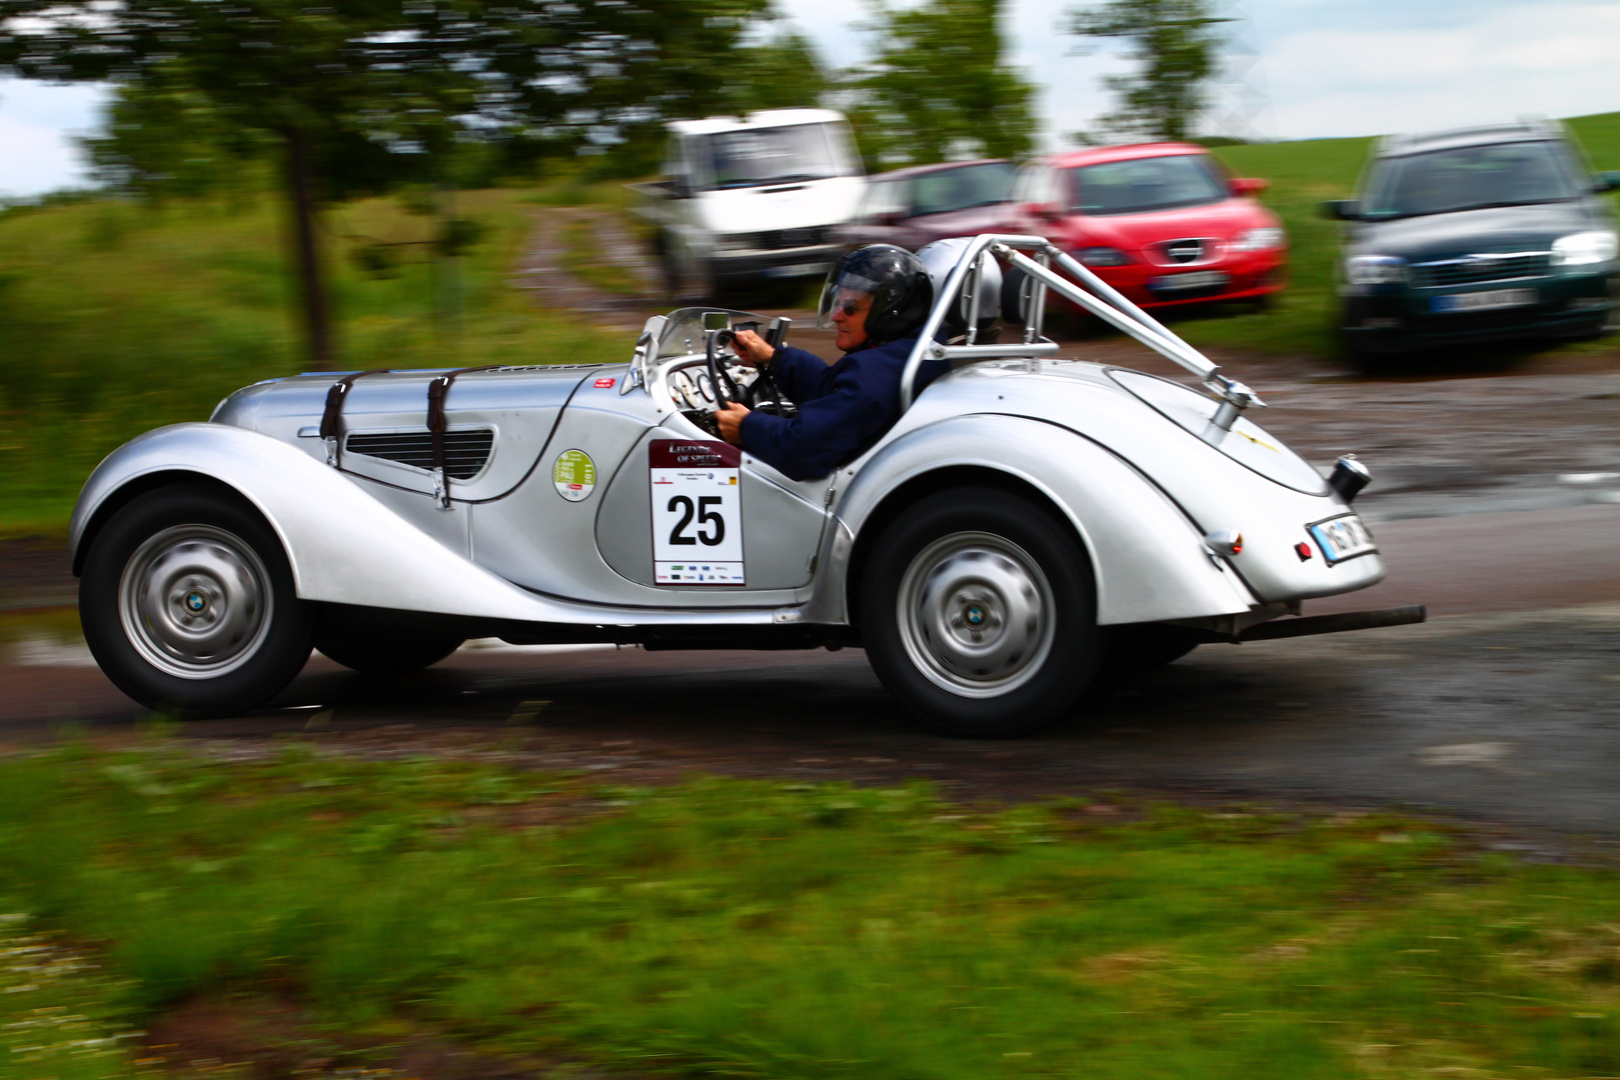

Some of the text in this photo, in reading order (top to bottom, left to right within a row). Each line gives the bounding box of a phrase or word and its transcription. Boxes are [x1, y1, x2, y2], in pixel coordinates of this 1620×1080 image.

[677, 455, 689, 463] OF
[584, 464, 593, 484] 2011
[667, 495, 725, 546] 25
